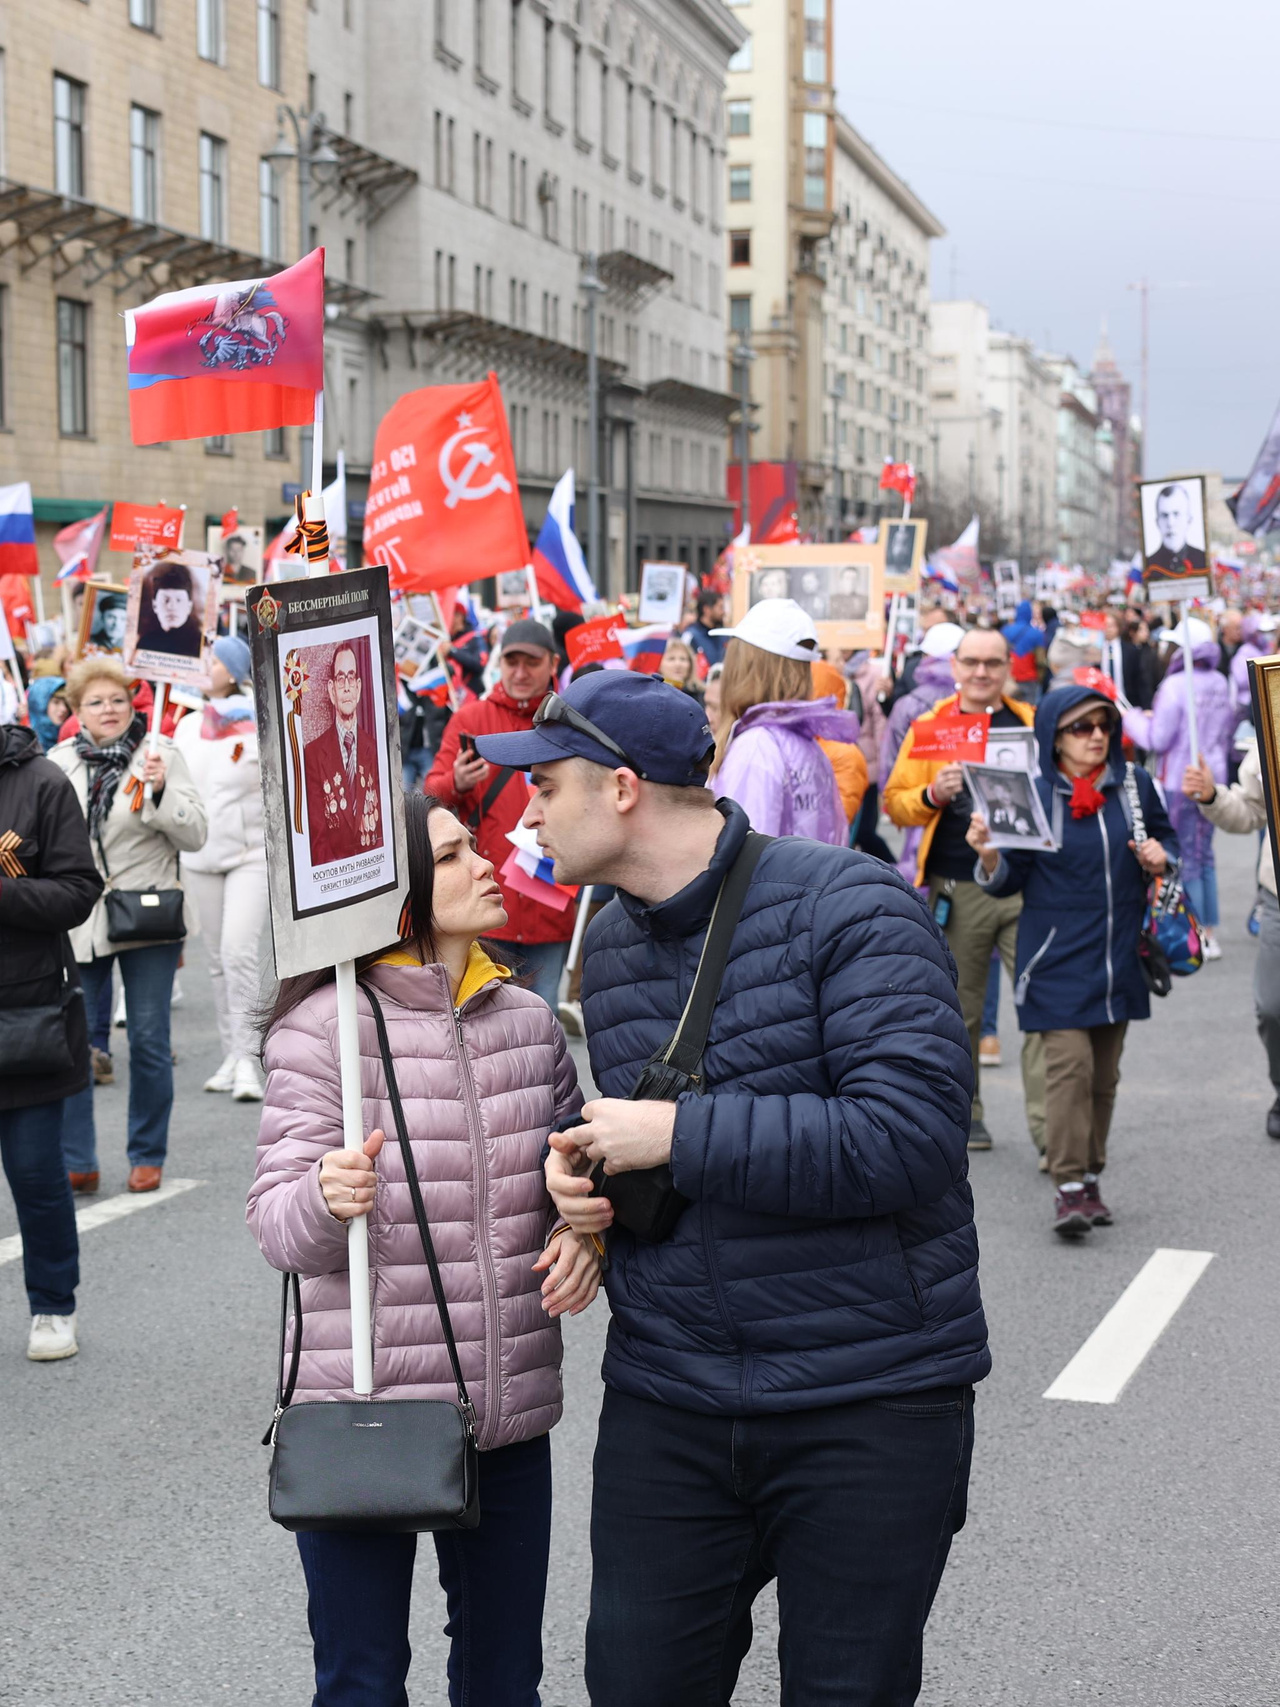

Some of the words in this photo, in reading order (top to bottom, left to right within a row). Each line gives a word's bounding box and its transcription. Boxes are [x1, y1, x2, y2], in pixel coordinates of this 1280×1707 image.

[287, 590, 350, 614] БЕССМЕРТНЫЙ
[351, 589, 370, 603] ПОЛК
[312, 868, 339, 880] ЮСУПОВ
[339, 862, 356, 873] МУТЫ
[355, 853, 385, 868] РИЗВАНОВИЧ
[320, 880, 342, 892] СВЯЗИСТ
[342, 874, 363, 886] ГВАРДИИ
[362, 867, 381, 879] РЯДОВОЙ
